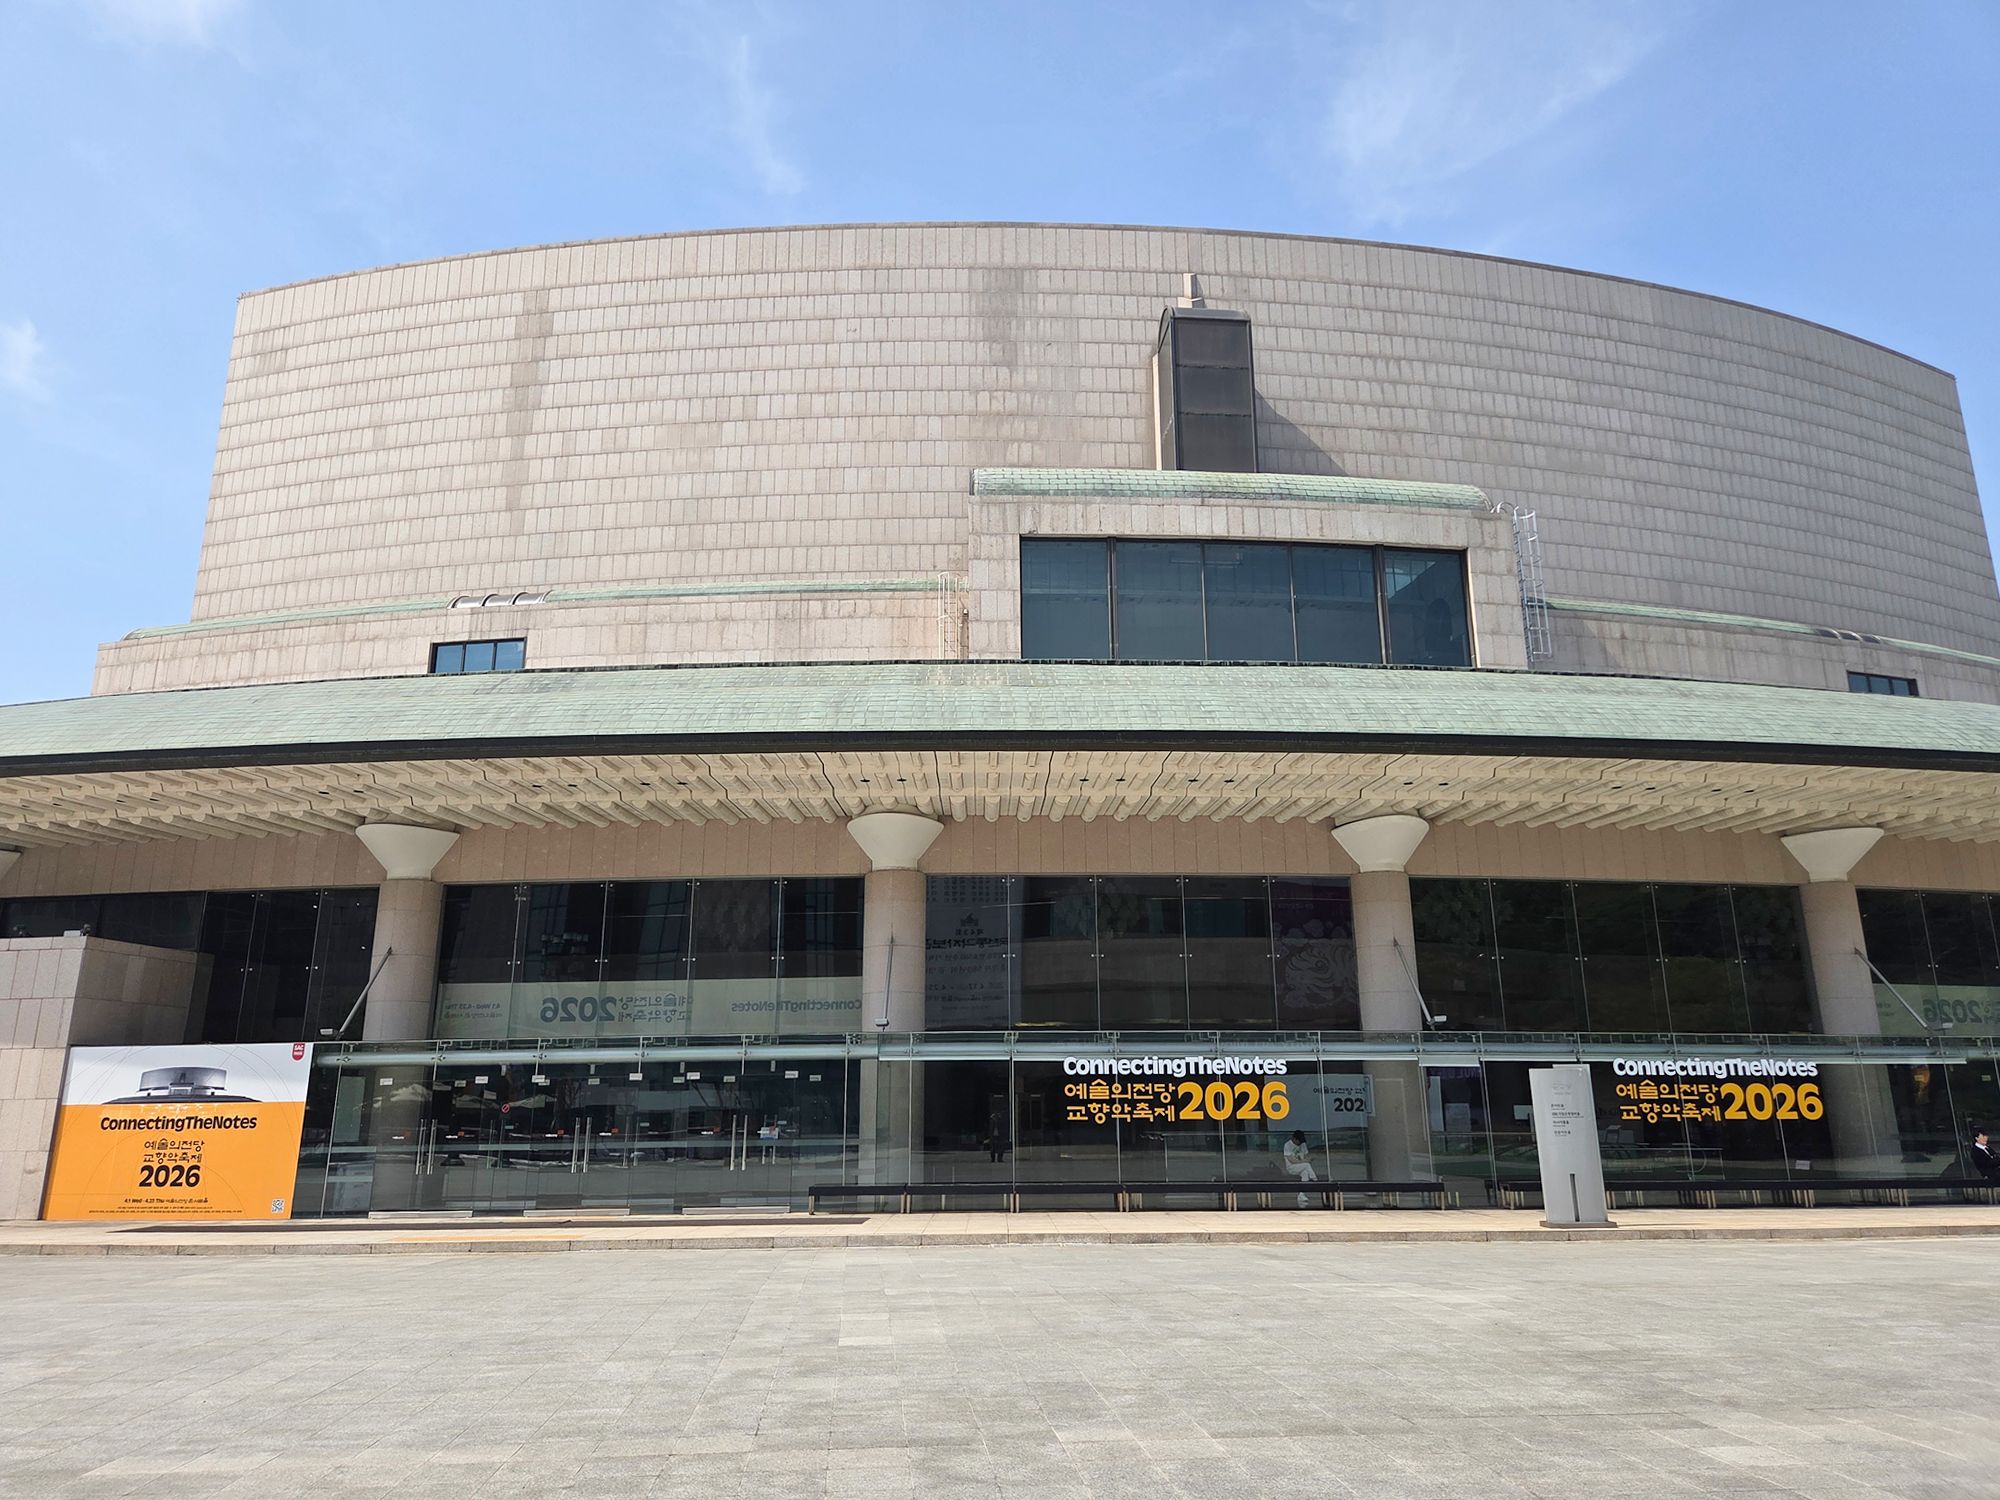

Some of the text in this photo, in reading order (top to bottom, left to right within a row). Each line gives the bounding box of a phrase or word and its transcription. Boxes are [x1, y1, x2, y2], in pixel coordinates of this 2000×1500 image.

[1063, 1056, 1288, 1078] ConnectingTheNotes
[1612, 1057, 1818, 1078] ConnectingTheNotes
[1064, 1078, 1176, 1103] 예술의전당
[1177, 1081, 1290, 1120] 2026
[1615, 1079, 1719, 1103] 예술의전당
[1719, 1082, 1824, 1121] 2026
[1066, 1102, 1175, 1124] 교향악축제
[1333, 1097, 1368, 1112] 202
[1619, 1103, 1721, 1124] 교향악축제
[100, 1115, 258, 1132] ConnectingTheNotes
[143, 1138, 206, 1152] 예술의전당
[143, 1152, 203, 1164] 교향악축제
[138, 1164, 201, 1188] 2026
